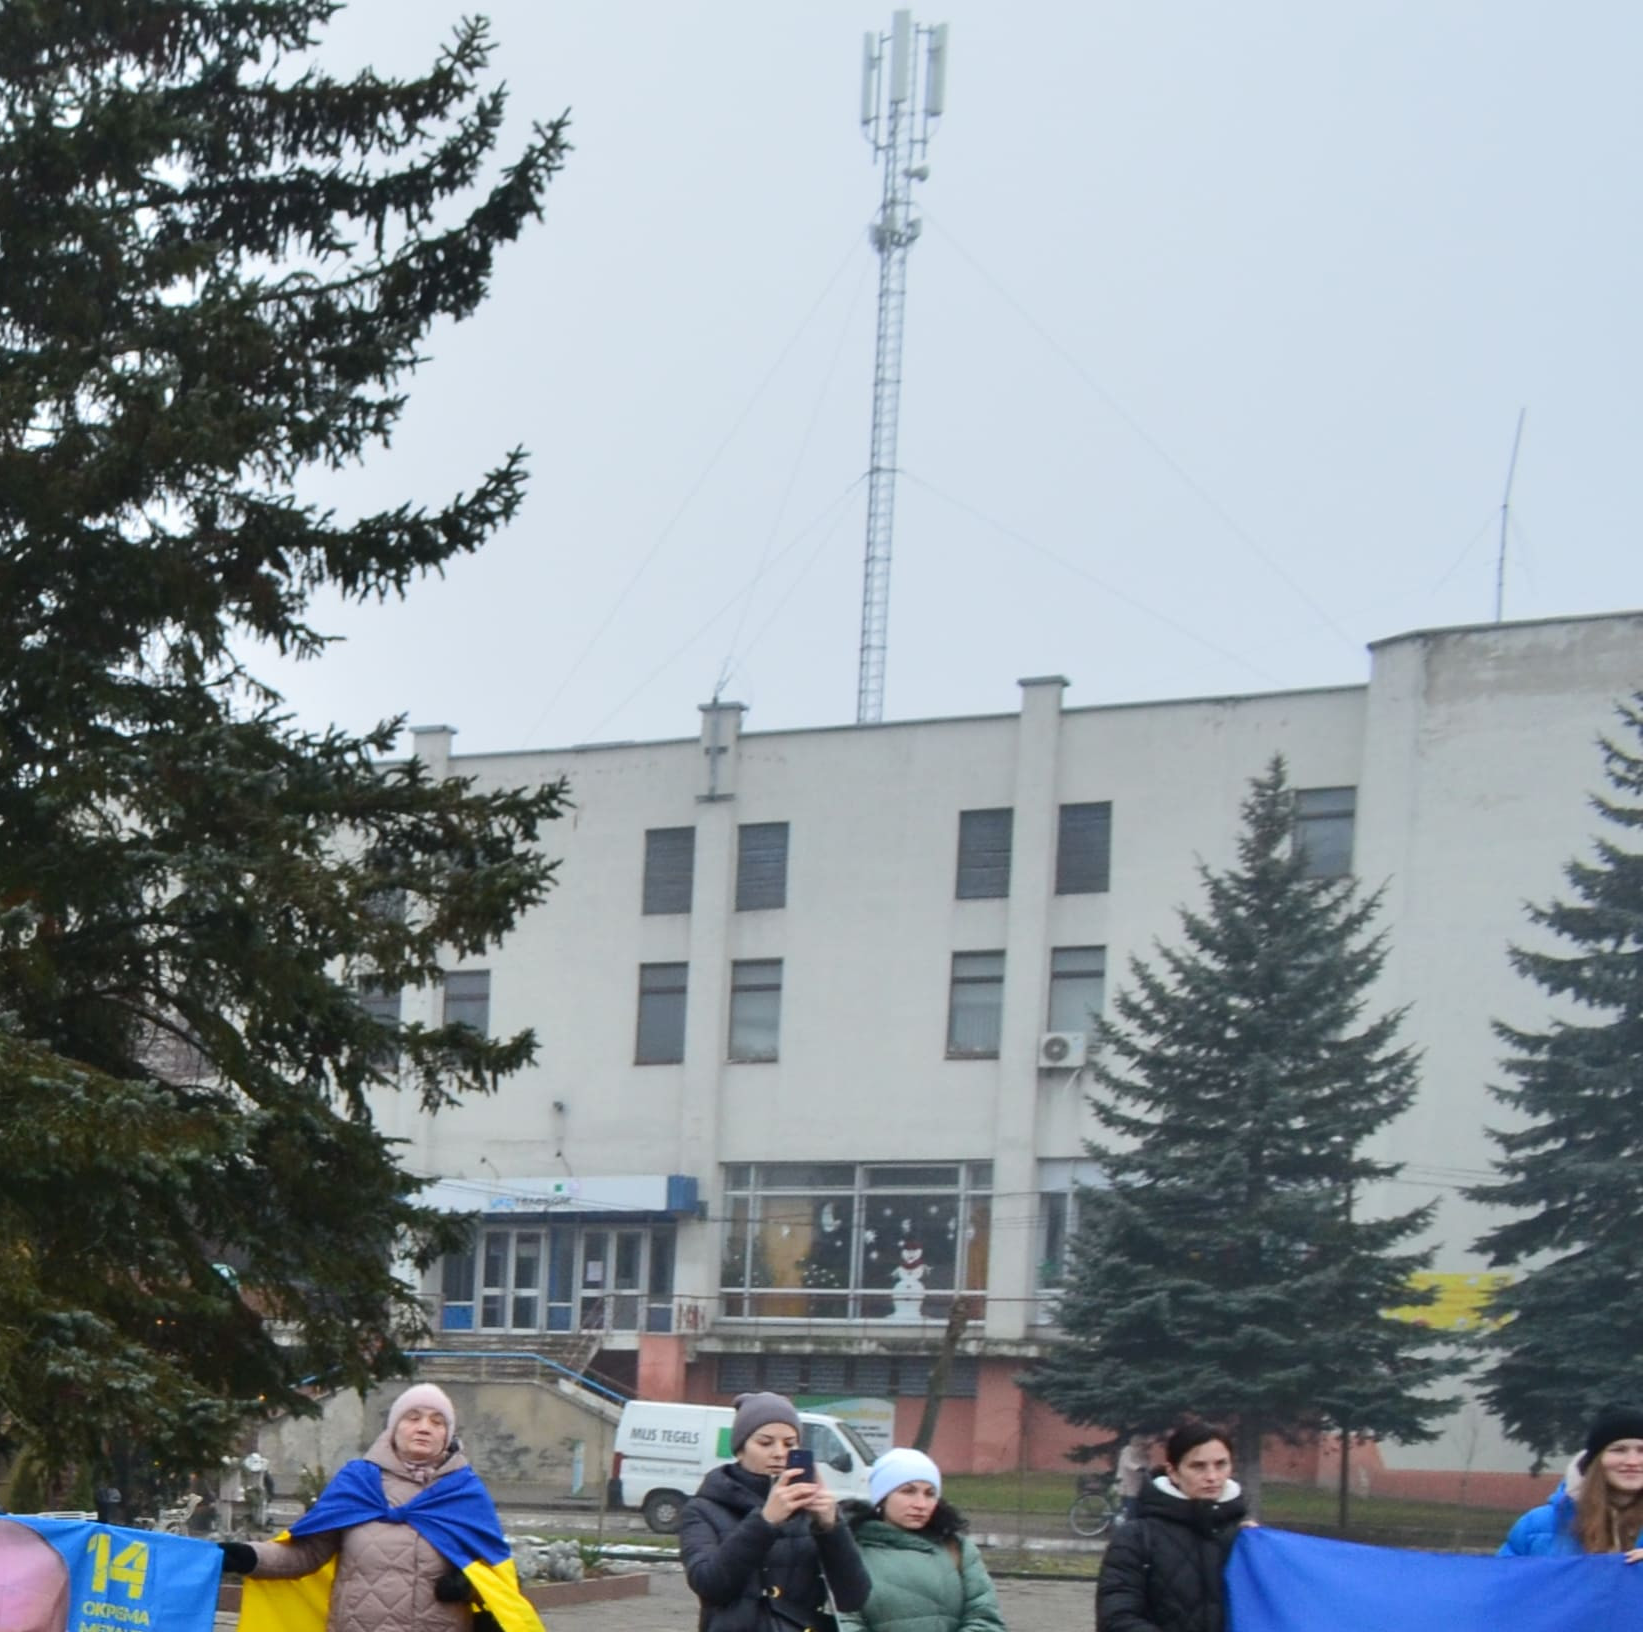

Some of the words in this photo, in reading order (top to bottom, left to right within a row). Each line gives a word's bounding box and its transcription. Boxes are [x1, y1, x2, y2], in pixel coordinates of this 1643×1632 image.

[661, 1429, 700, 1445] TEGELS
[86, 1532, 150, 1600] 14
[81, 1599, 150, 1627] ОКРЕМА
